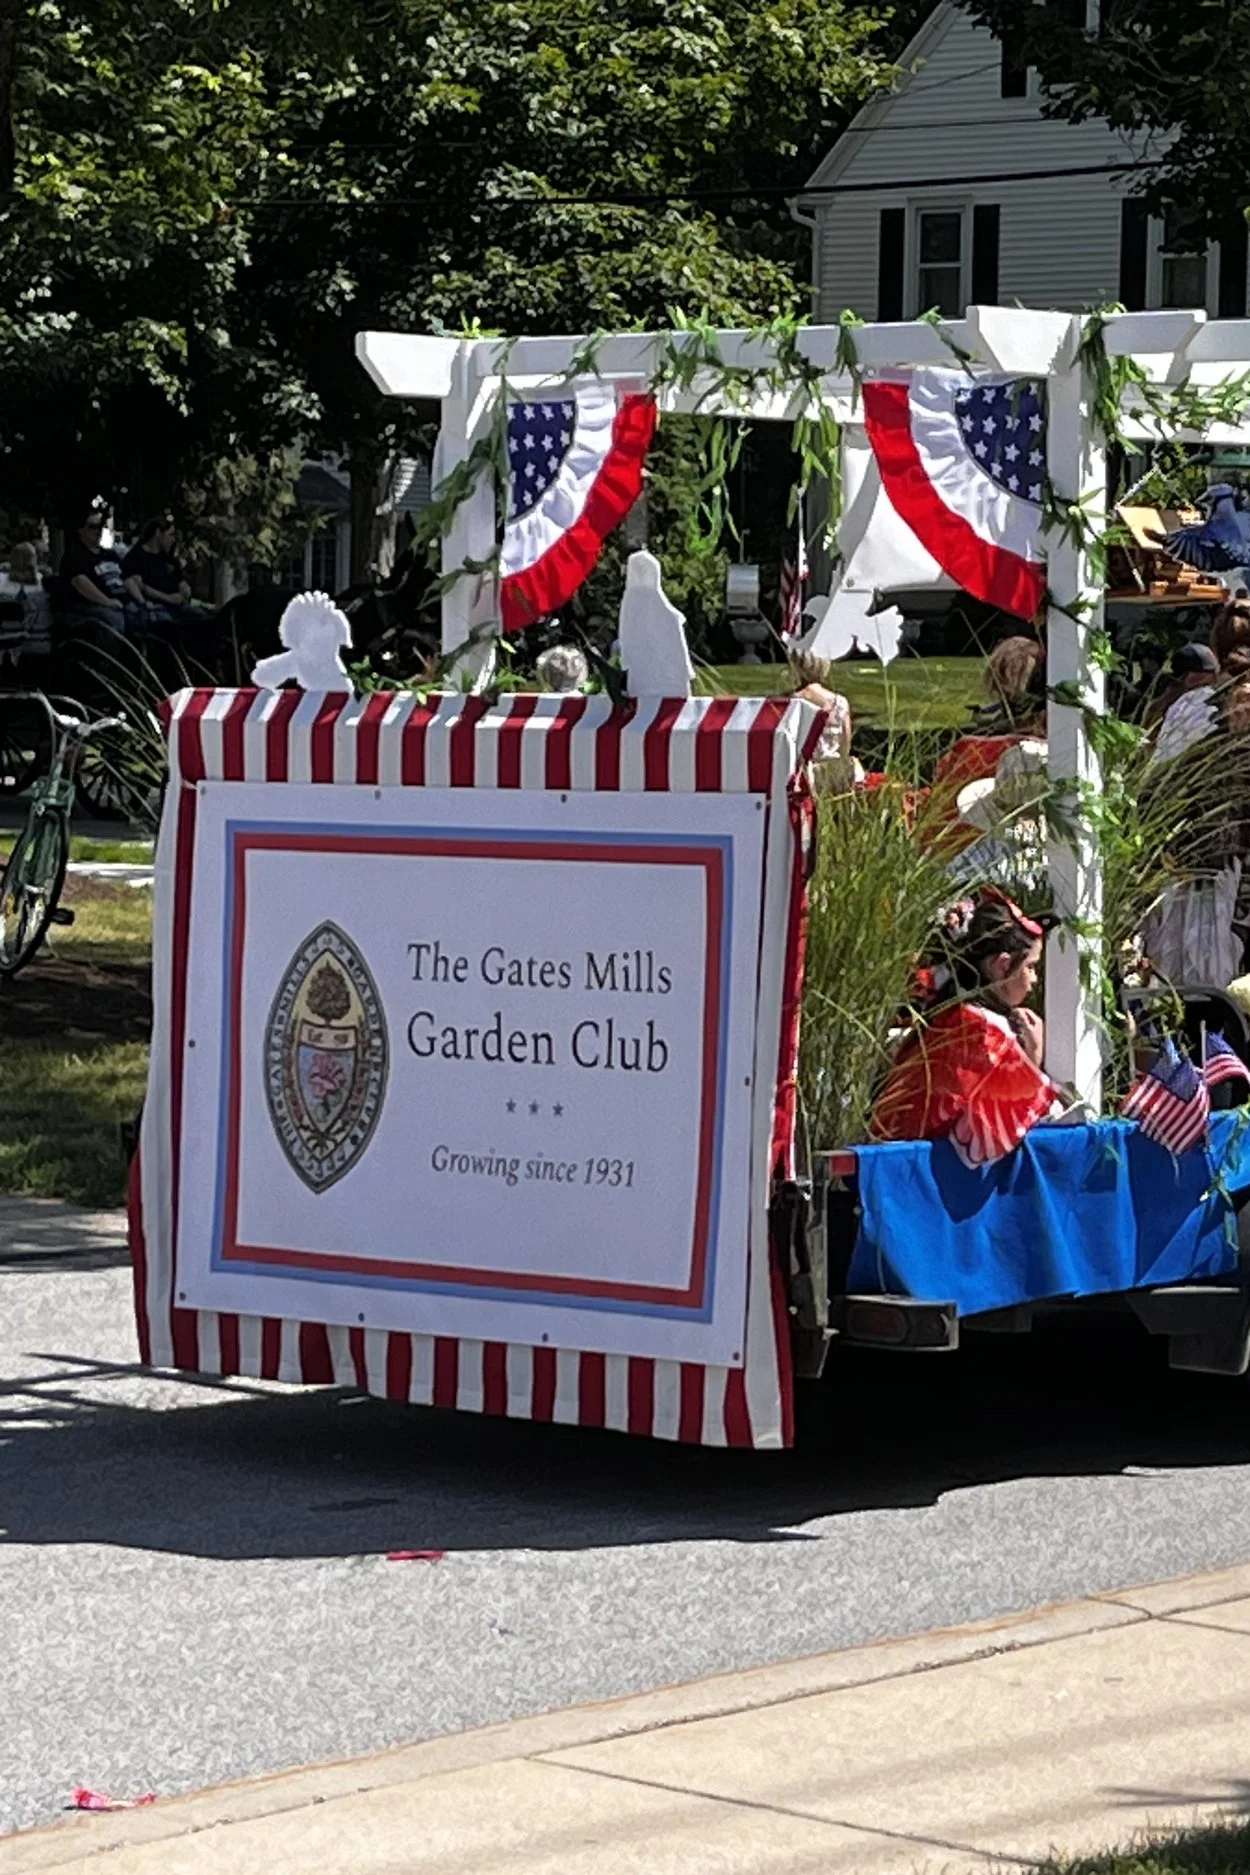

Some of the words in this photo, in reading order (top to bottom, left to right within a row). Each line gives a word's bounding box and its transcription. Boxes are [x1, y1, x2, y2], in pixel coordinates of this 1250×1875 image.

[407, 940, 469, 983] The
[480, 947, 572, 990] Gates
[584, 950, 673, 994] Mills
[407, 1011, 556, 1066] Garden
[571, 1017, 669, 1073] Club
[431, 1145, 519, 1187] Growing
[524, 1152, 577, 1183] since
[584, 1157, 636, 1188] 1931
